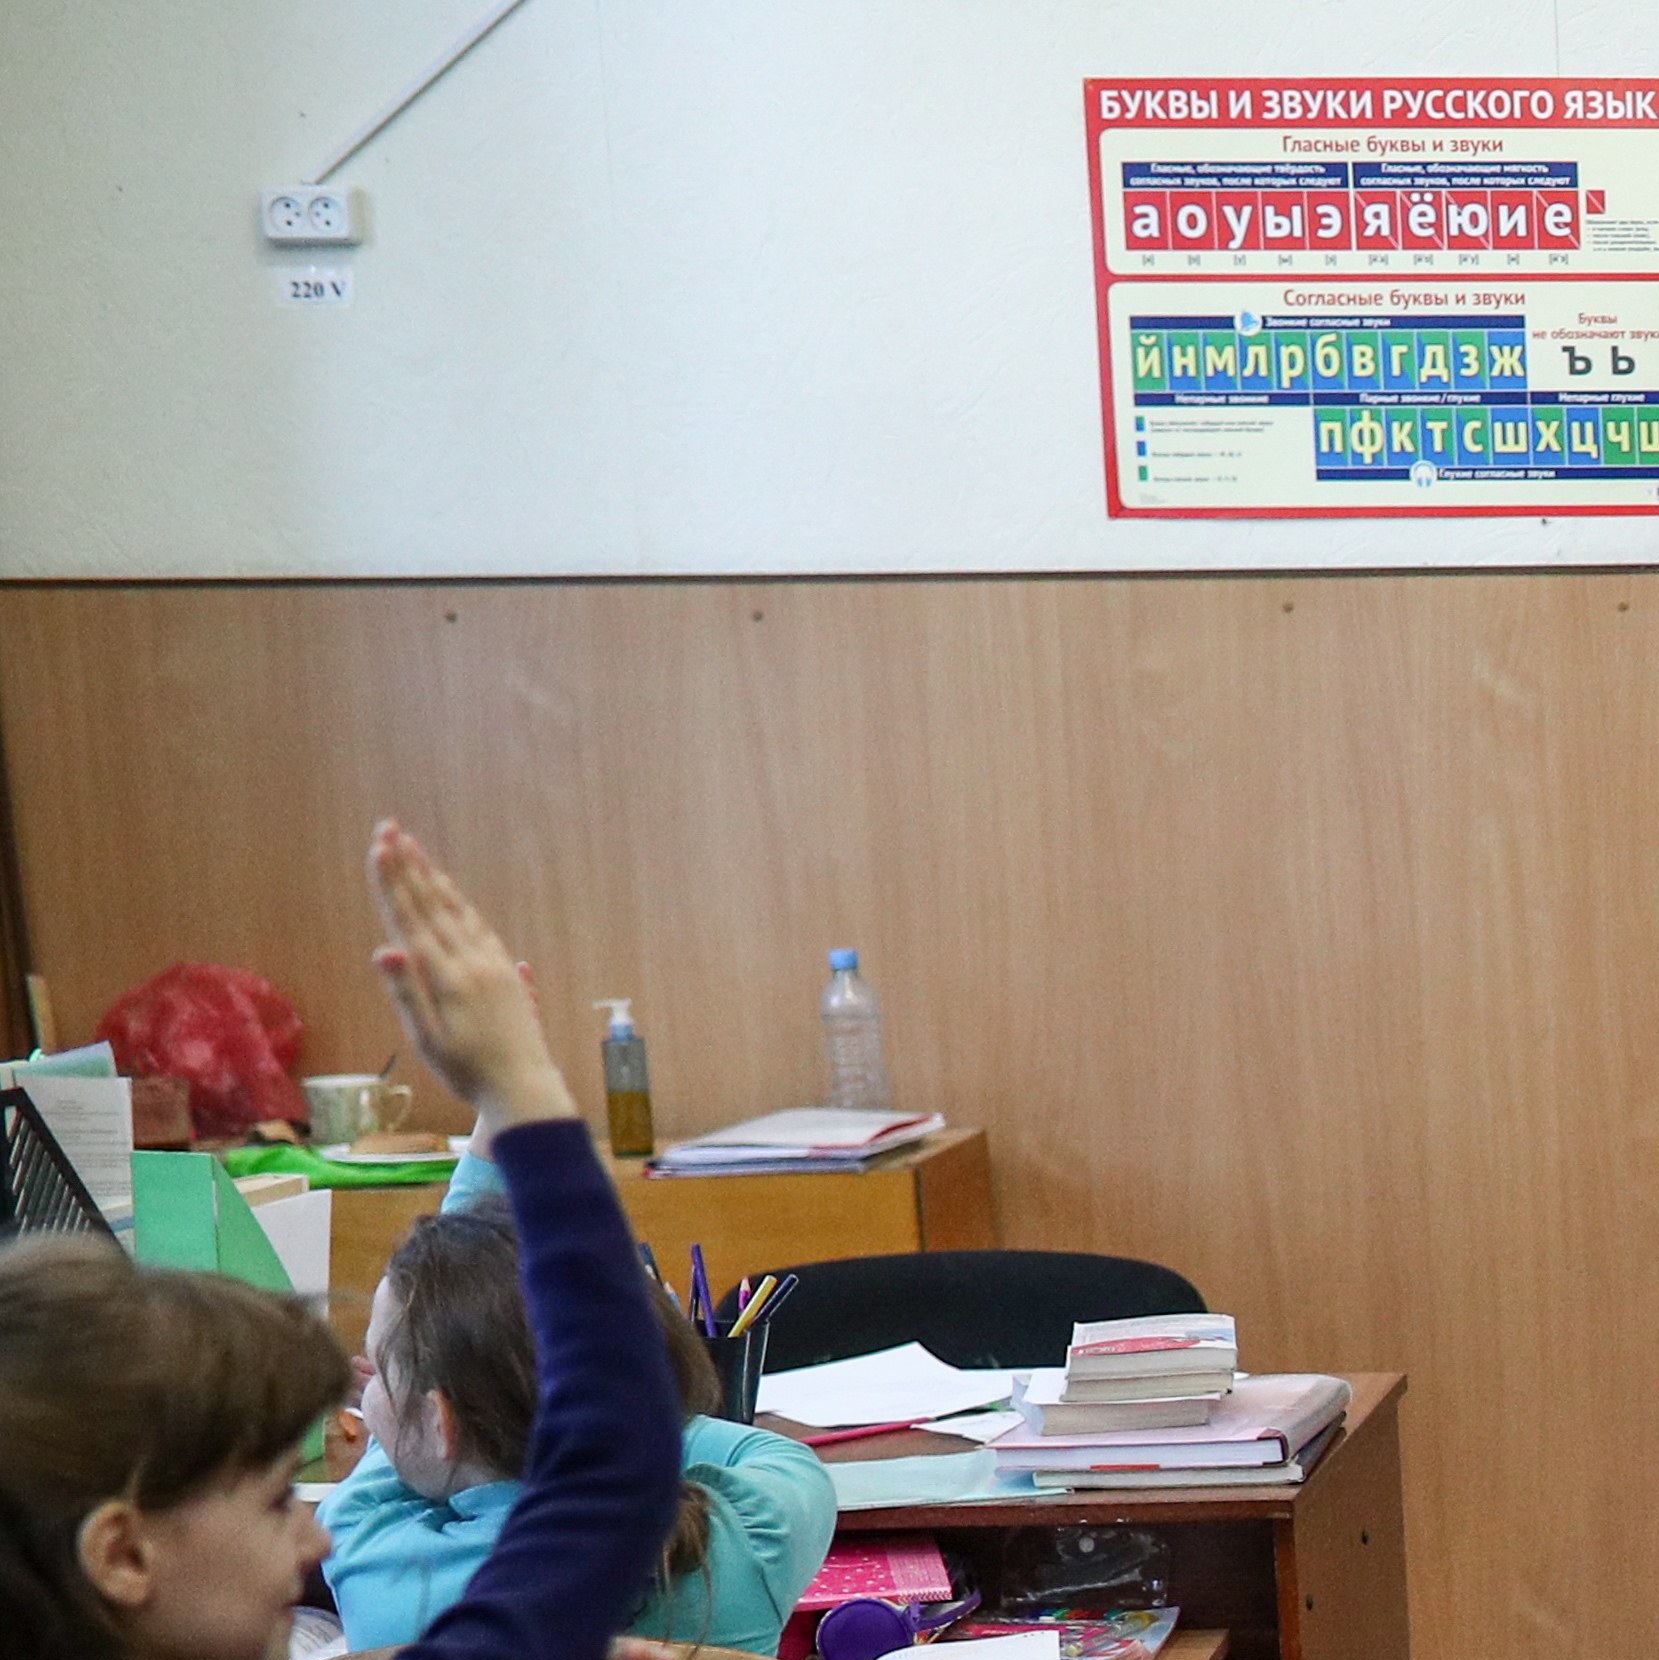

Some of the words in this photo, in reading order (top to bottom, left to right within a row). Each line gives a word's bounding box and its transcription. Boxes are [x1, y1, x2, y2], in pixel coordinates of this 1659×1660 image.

[1100, 89, 1219, 119] БУКВЫ
[1229, 92, 1250, 119] И
[1262, 92, 1373, 119] ЗВУКИ
[1382, 90, 1554, 120] РУССКОГО
[1283, 135, 1361, 153] Гласные
[1367, 135, 1428, 156] буквы
[1433, 137, 1445, 152] и
[1451, 137, 1503, 156] звуки
[291, 281, 324, 297] 220
[1283, 289, 1385, 309] Согласные
[1391, 289, 1451, 309] буквы
[1455, 293, 1467, 306] и
[1473, 293, 1525, 310] звуки
[1579, 313, 1617, 325] Буквы
[1532, 330, 1546, 339] не
[1551, 329, 1625, 339] обозначают
